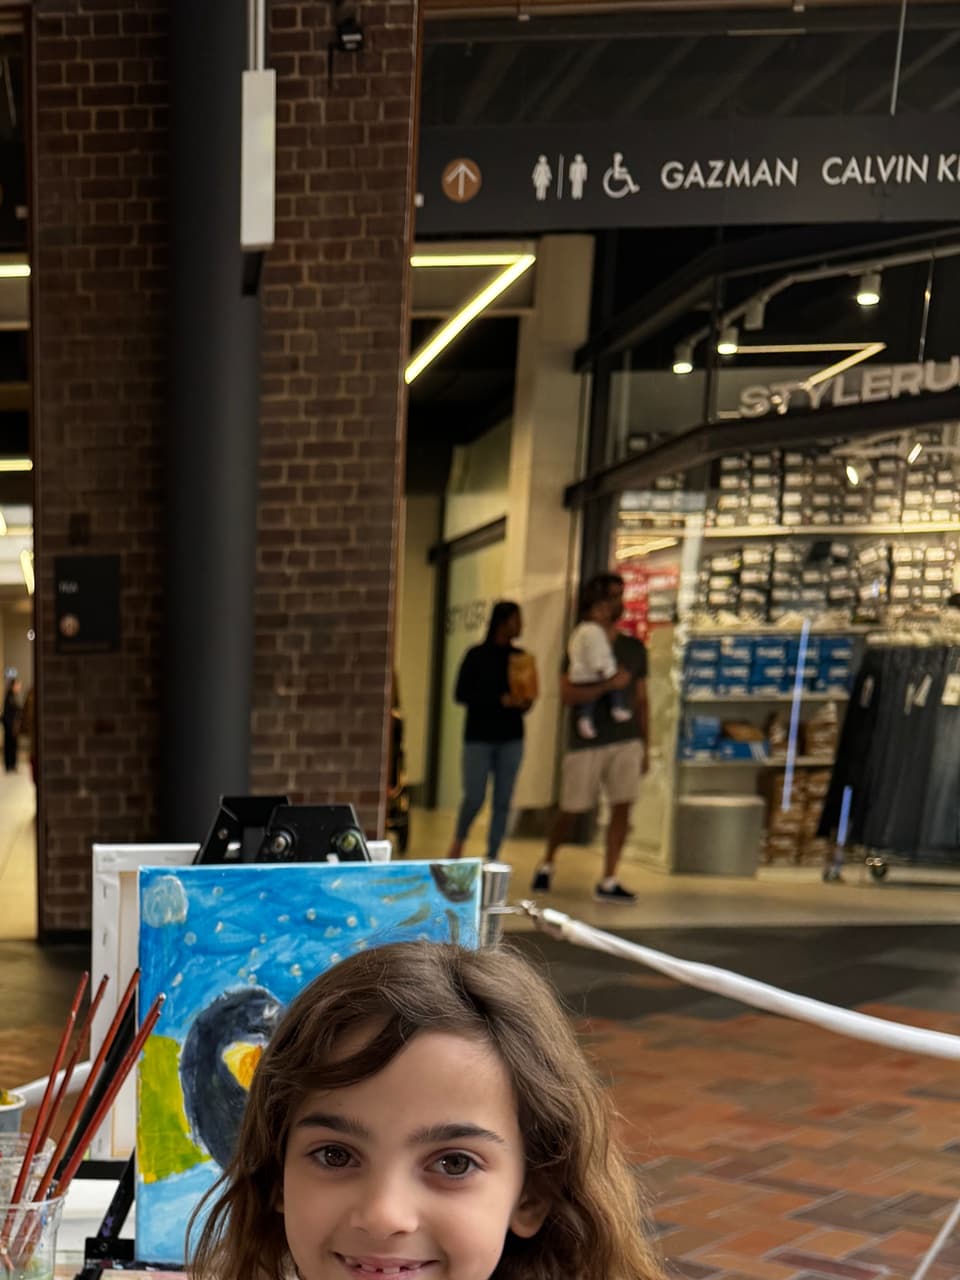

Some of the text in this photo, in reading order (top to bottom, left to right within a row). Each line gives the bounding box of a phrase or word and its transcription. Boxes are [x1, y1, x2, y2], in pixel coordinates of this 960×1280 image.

[660, 153, 960, 190] GAZMAN CALVIN K
